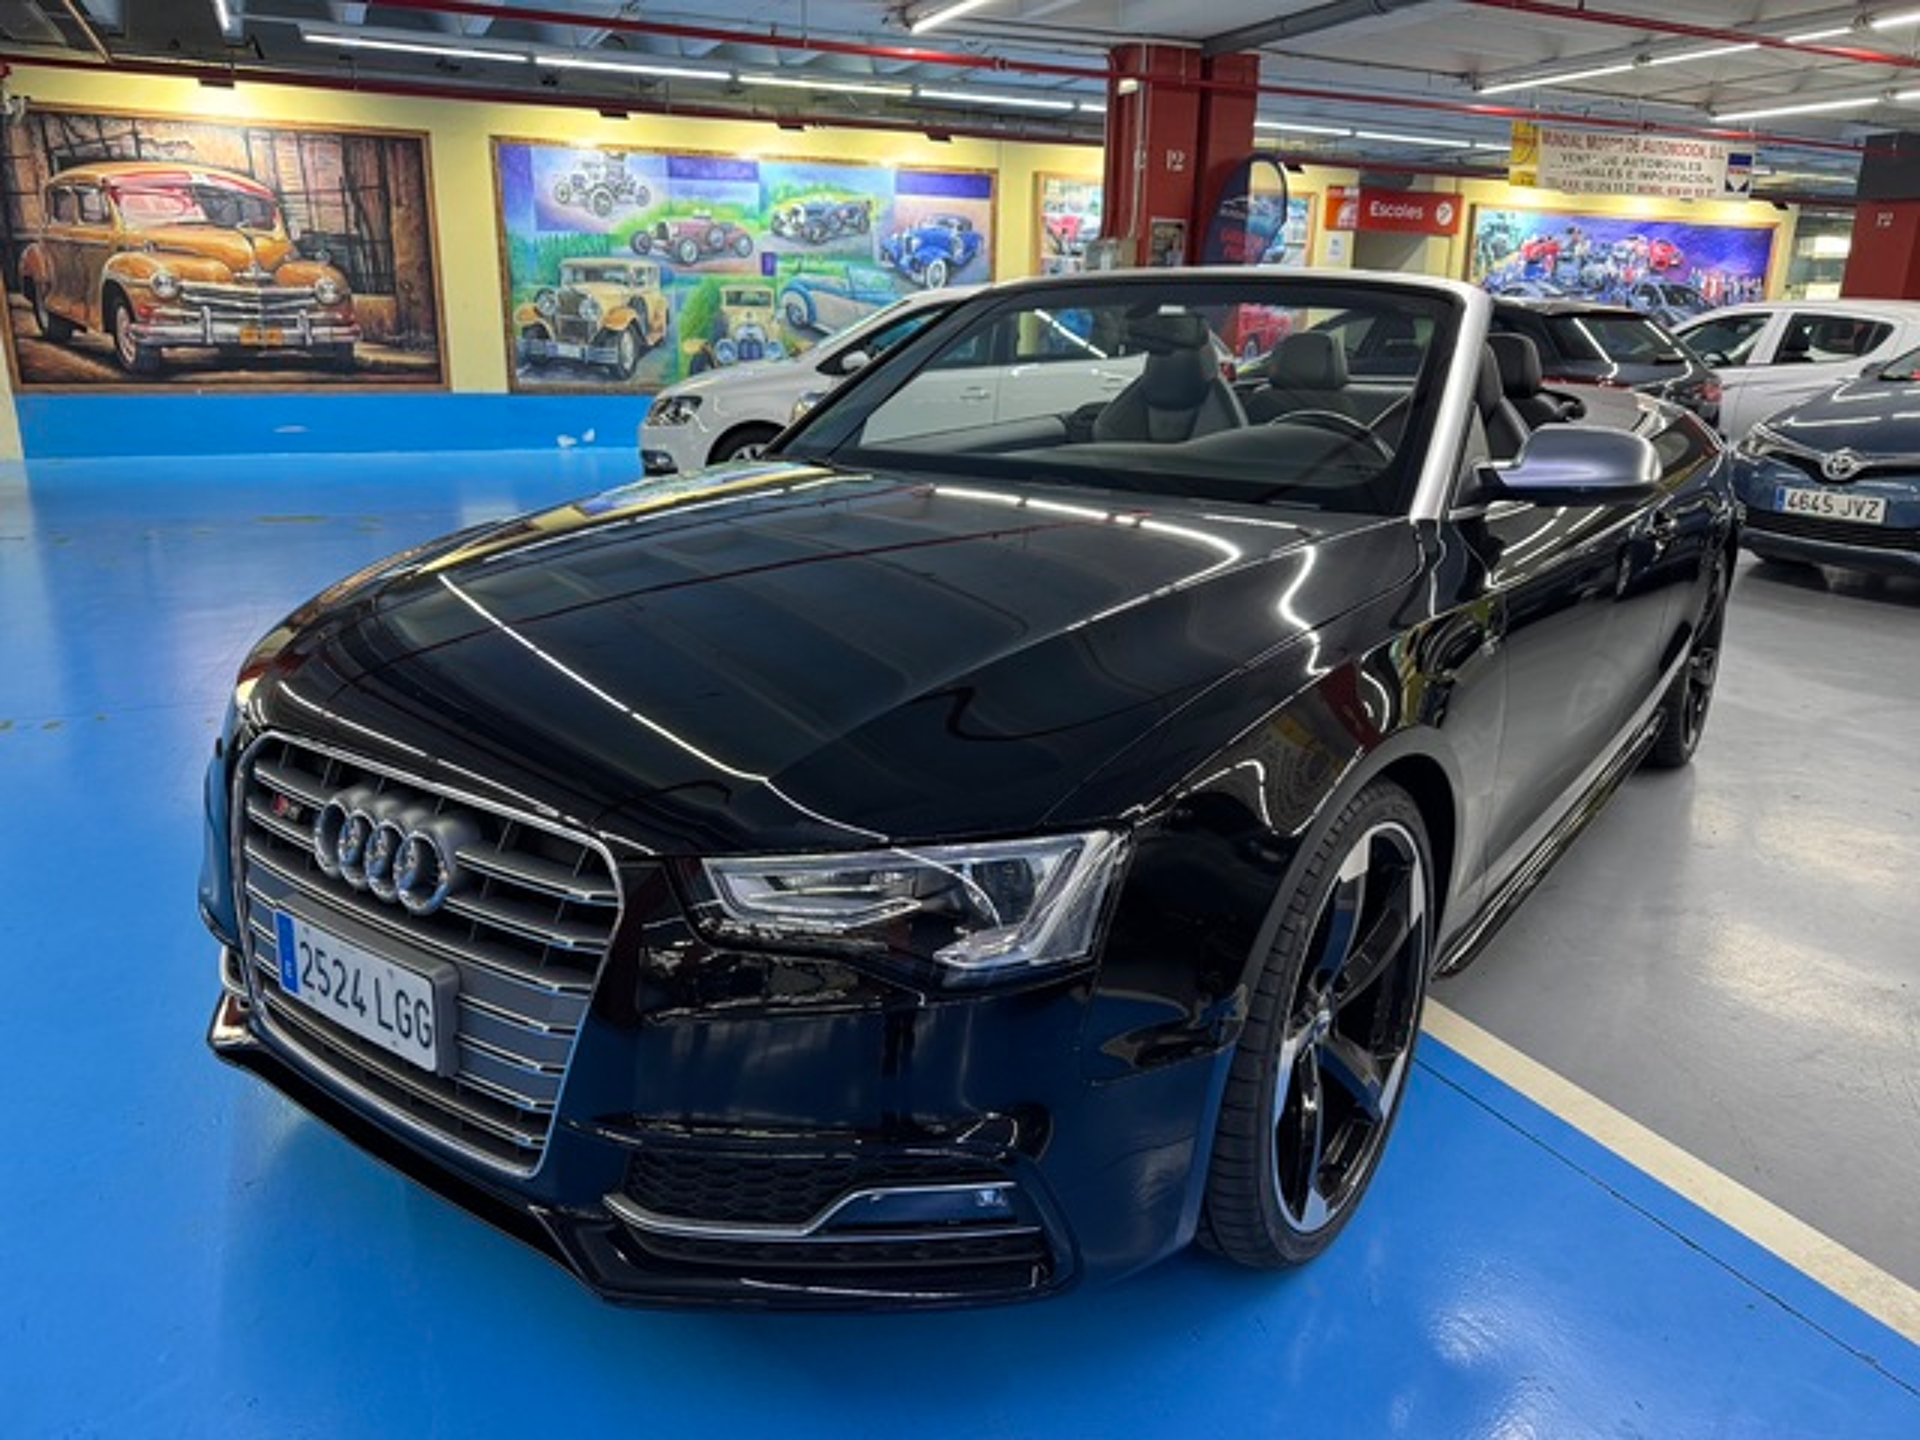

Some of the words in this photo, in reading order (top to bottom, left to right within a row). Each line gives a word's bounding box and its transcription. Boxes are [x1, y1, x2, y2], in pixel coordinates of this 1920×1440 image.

[1788, 491, 1834, 514] 4645
[1838, 498, 1880, 519] JVZ
[300, 940, 367, 1018] 2524
[374, 976, 433, 1050] LGG
